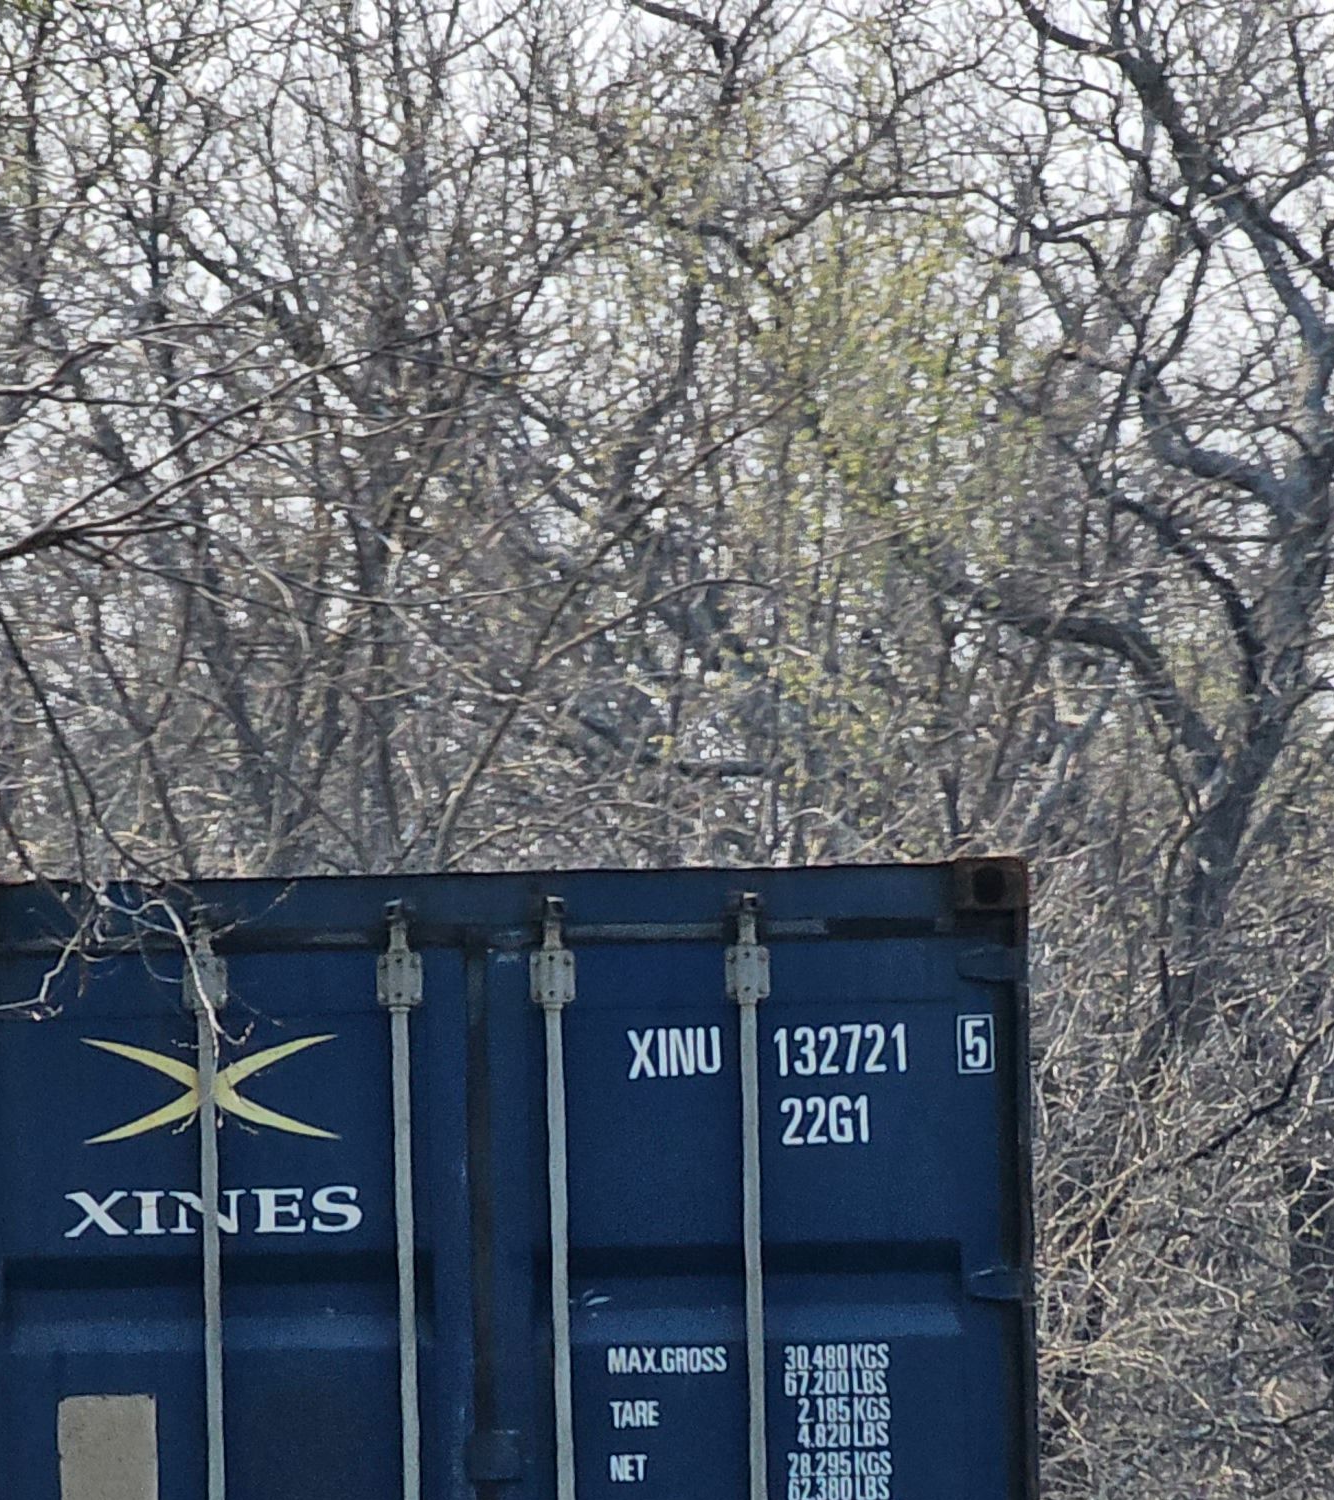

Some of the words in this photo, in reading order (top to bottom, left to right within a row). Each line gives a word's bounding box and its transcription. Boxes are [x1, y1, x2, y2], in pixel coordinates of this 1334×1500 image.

[627, 1026, 722, 1080] XINU
[773, 1022, 909, 1077] 132721
[963, 1017, 988, 1070] 5
[779, 1094, 870, 1146] 22G1
[63, 1185, 363, 1238] XINES
[783, 1343, 848, 1371] 30.480
[849, 1342, 890, 1370] KGS
[783, 1369, 850, 1397] 67.200
[851, 1369, 888, 1395] LBS
[609, 1400, 661, 1430] TARE
[797, 1397, 851, 1424] 2.185
[852, 1396, 892, 1421] KGS
[797, 1422, 851, 1448] 4.820
[852, 1420, 890, 1447] LBS
[610, 1453, 648, 1483] NET
[787, 1451, 852, 1478] 28.295
[853, 1450, 893, 1476] KGS
[854, 1475, 891, 1500] LBS
